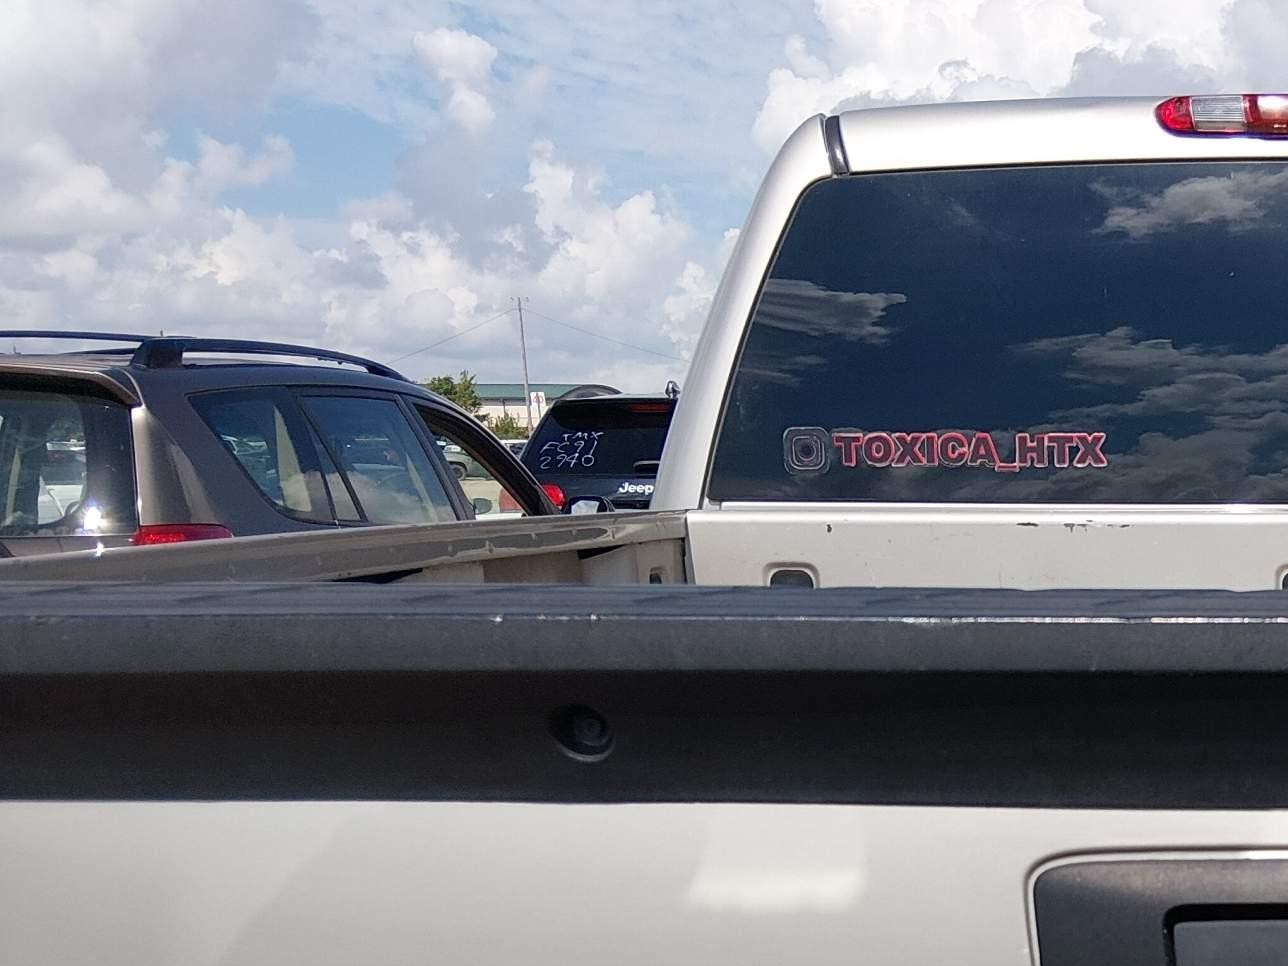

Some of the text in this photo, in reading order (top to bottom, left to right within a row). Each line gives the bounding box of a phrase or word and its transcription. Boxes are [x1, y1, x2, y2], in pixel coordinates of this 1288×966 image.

[832, 432, 1107, 471] TOXICA_HTX
[539, 453, 595, 470] 2940
[618, 482, 655, 496] Jeep
